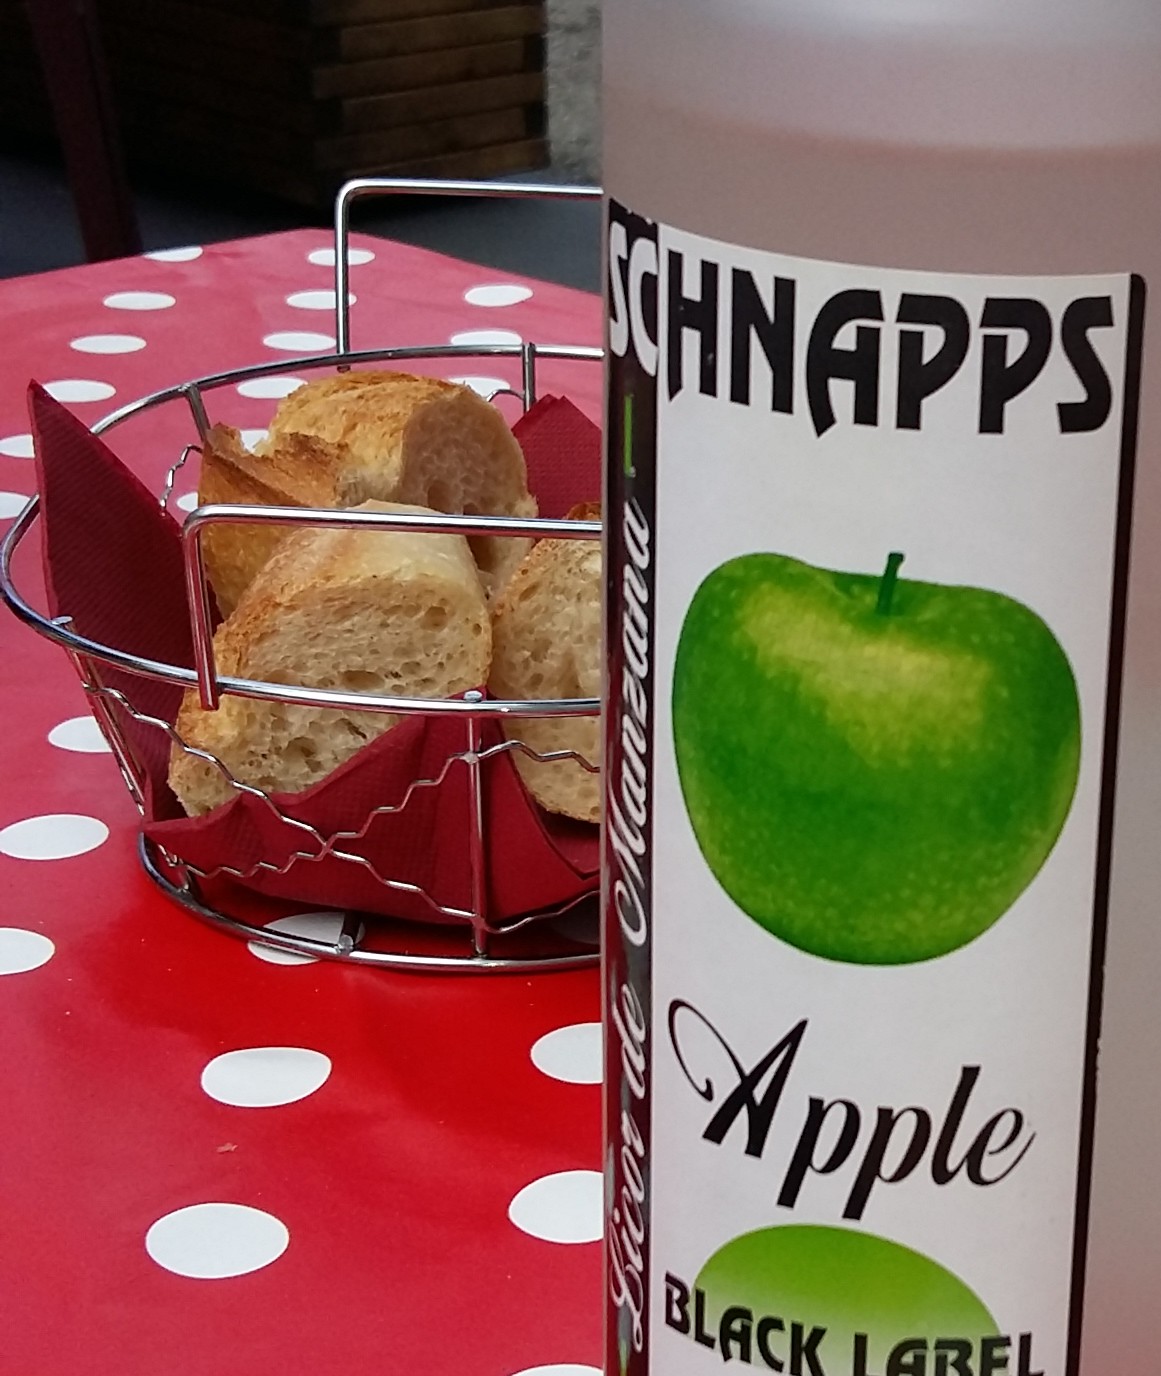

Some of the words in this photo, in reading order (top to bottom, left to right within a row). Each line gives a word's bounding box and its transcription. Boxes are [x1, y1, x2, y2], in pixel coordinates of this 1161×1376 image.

[608, 220, 1115, 439] SCHNAPPS
[607, 496, 650, 947] Manzana
[667, 998, 1037, 1221] Apple
